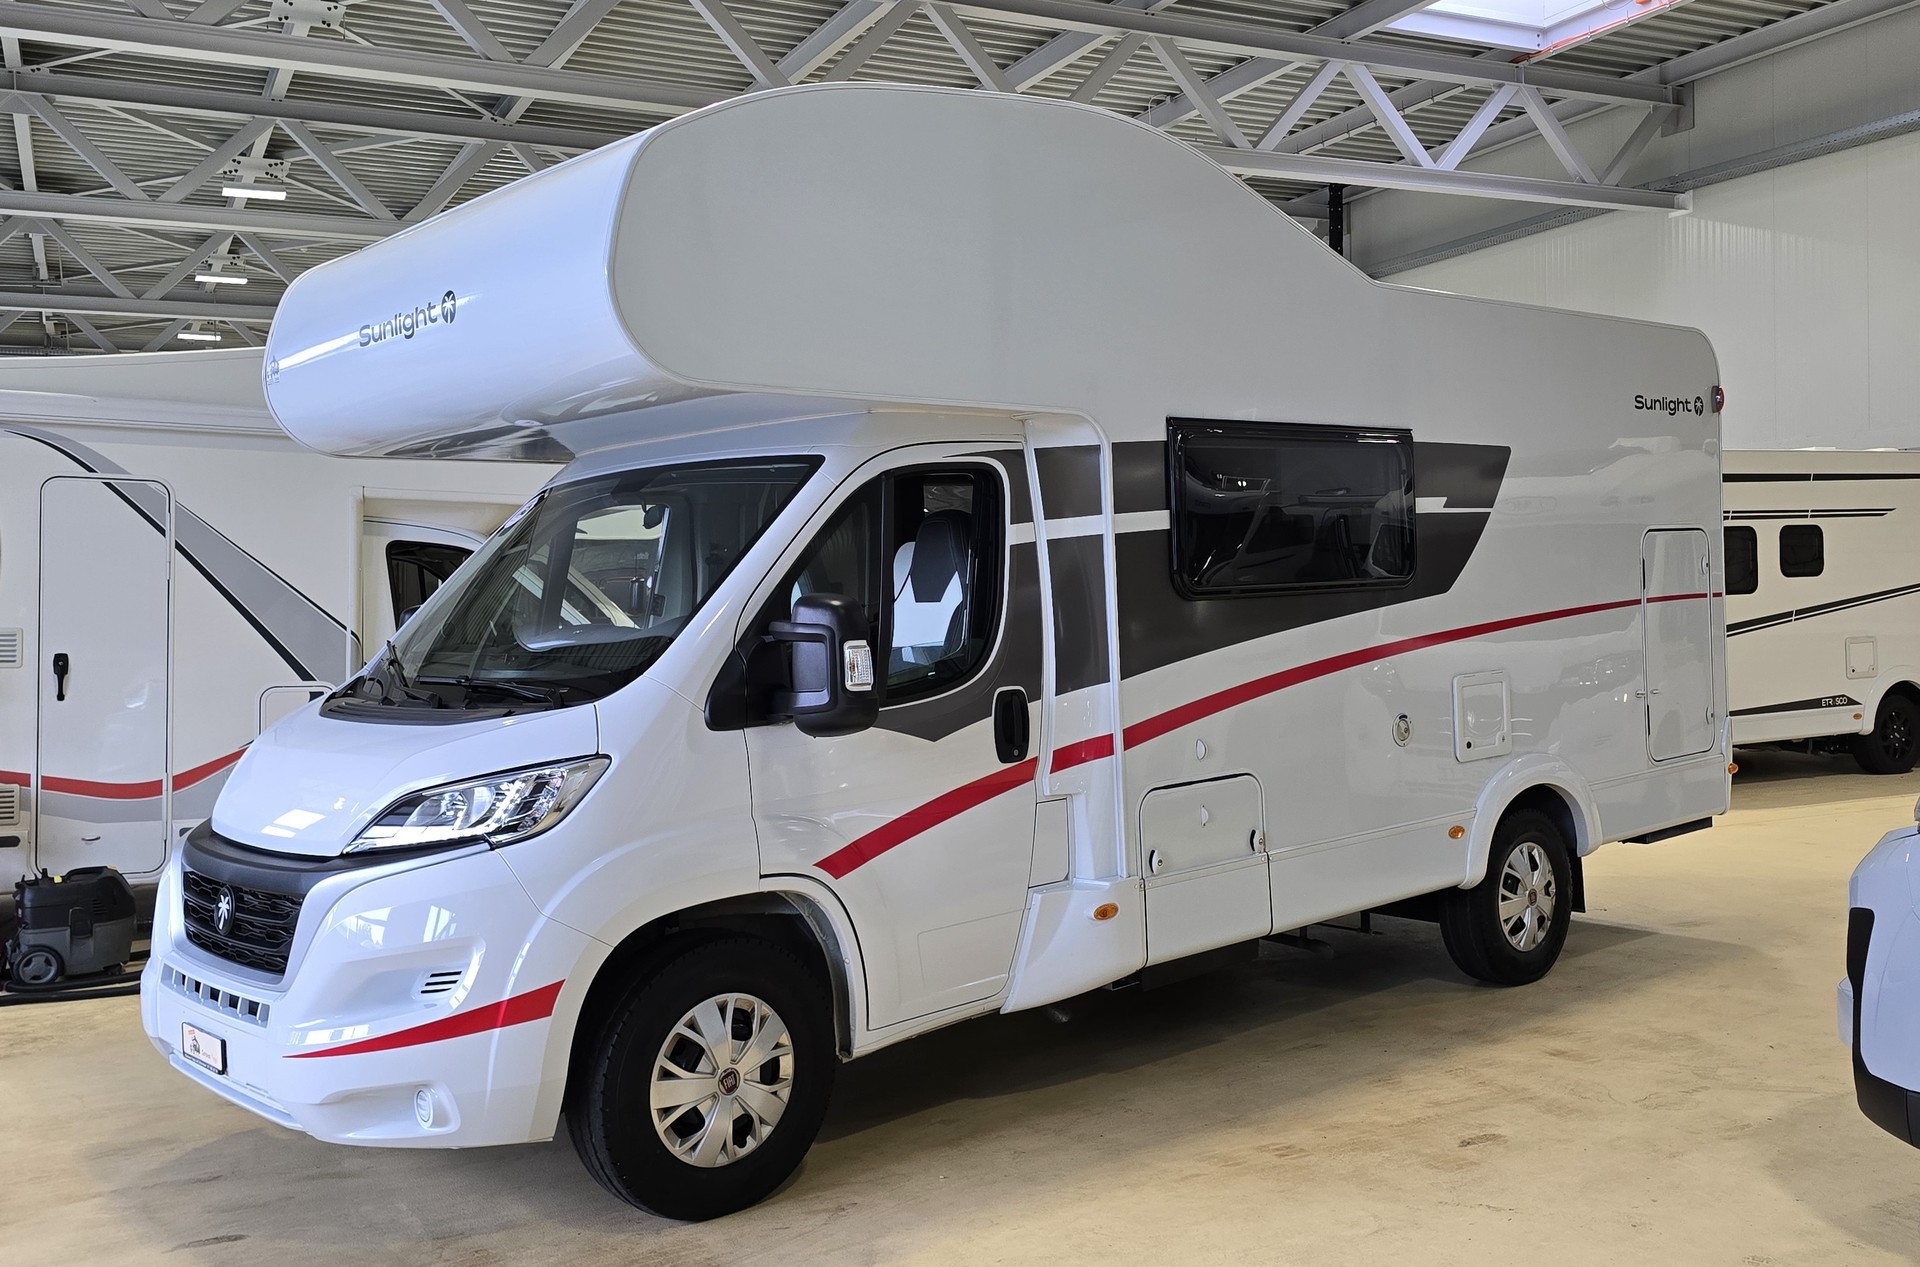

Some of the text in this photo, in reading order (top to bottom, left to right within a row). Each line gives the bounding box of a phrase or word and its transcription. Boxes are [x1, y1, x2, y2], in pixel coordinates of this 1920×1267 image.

[359, 302, 438, 347] Sunlight
[1634, 395, 1692, 416] Sunlight
[1821, 696, 1848, 707] ETRSCO
